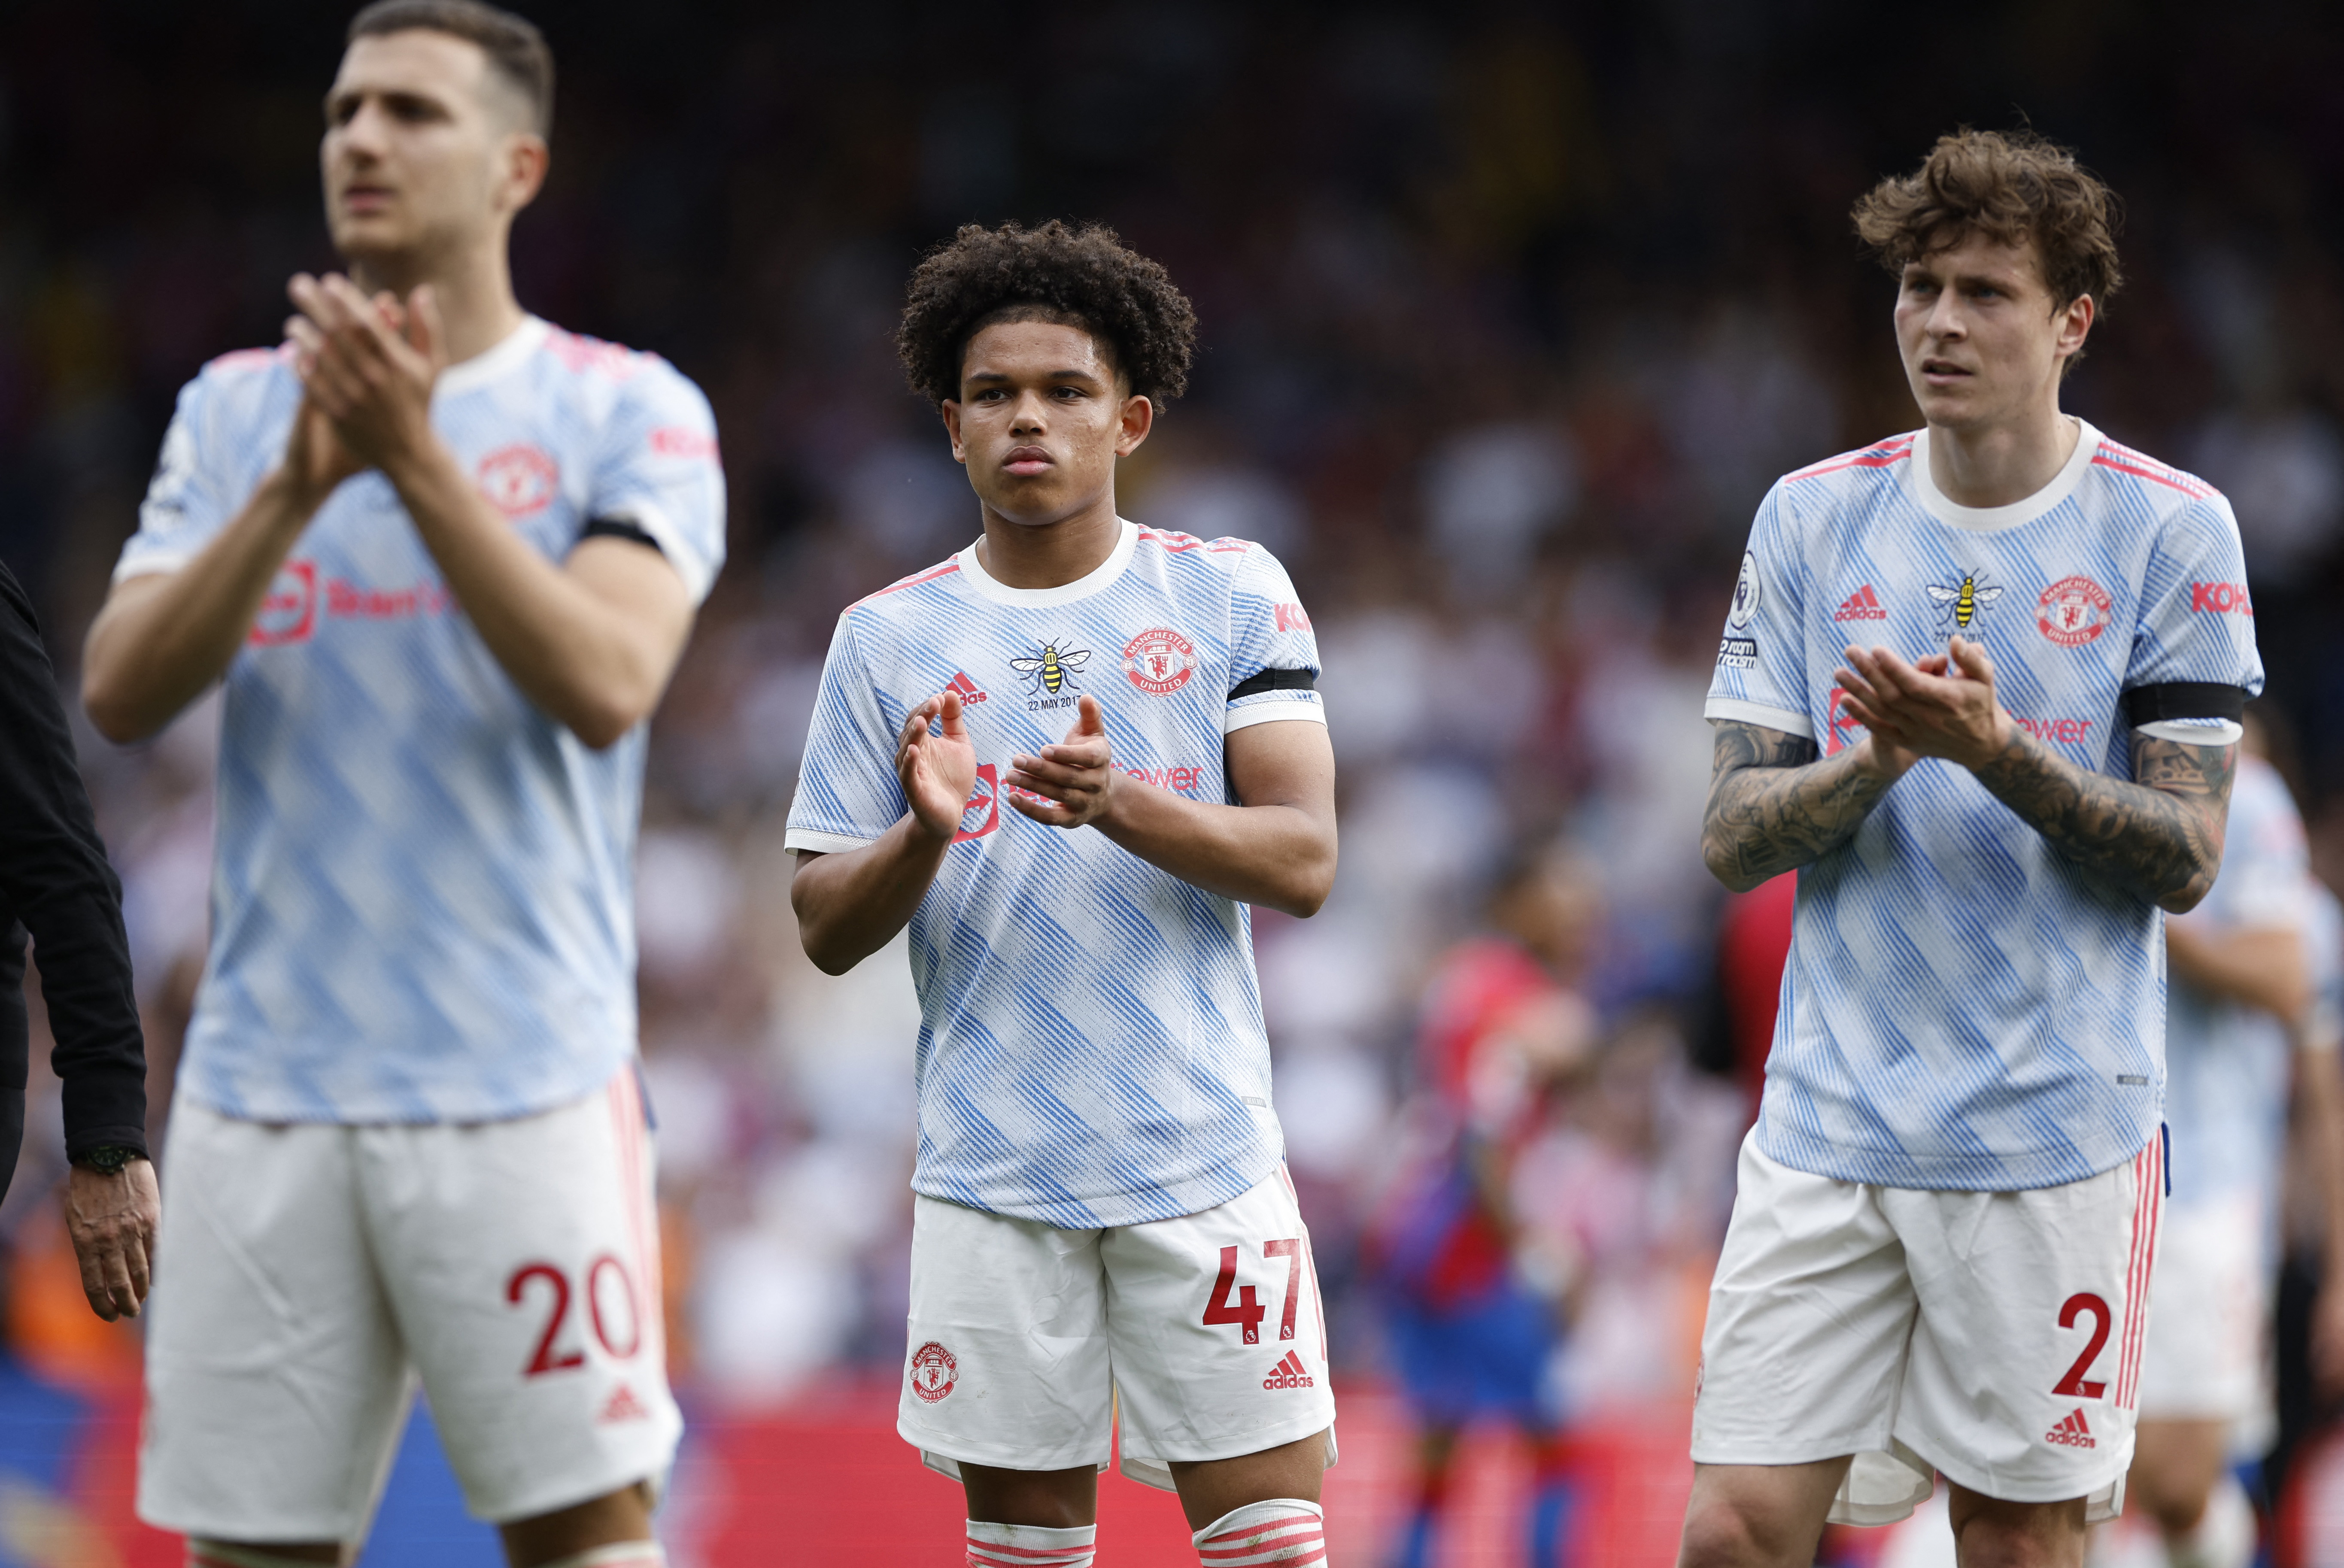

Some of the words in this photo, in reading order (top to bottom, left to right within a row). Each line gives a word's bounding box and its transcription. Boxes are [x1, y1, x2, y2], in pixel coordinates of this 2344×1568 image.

[2044, 580, 2107, 606] MANCHESTER
[1834, 607, 1887, 622] adidas
[1127, 631, 1189, 655] MANCHESTER
[2047, 628, 2091, 642] UNITED
[1727, 640, 1754, 656] room
[1140, 678, 1182, 692] UNITED
[1028, 701, 1039, 711] 22
[1041, 698, 1058, 710] MAY
[1202, 1238, 1301, 1345] 47
[502, 1254, 641, 1379] 20
[2051, 1292, 2111, 1399] 2
[915, 1346, 953, 1367] MANCHESTER
[1263, 1374, 1314, 1390] adidas
[919, 1388, 946, 1399] UNITED
[2045, 1429, 2096, 1449] adidas
